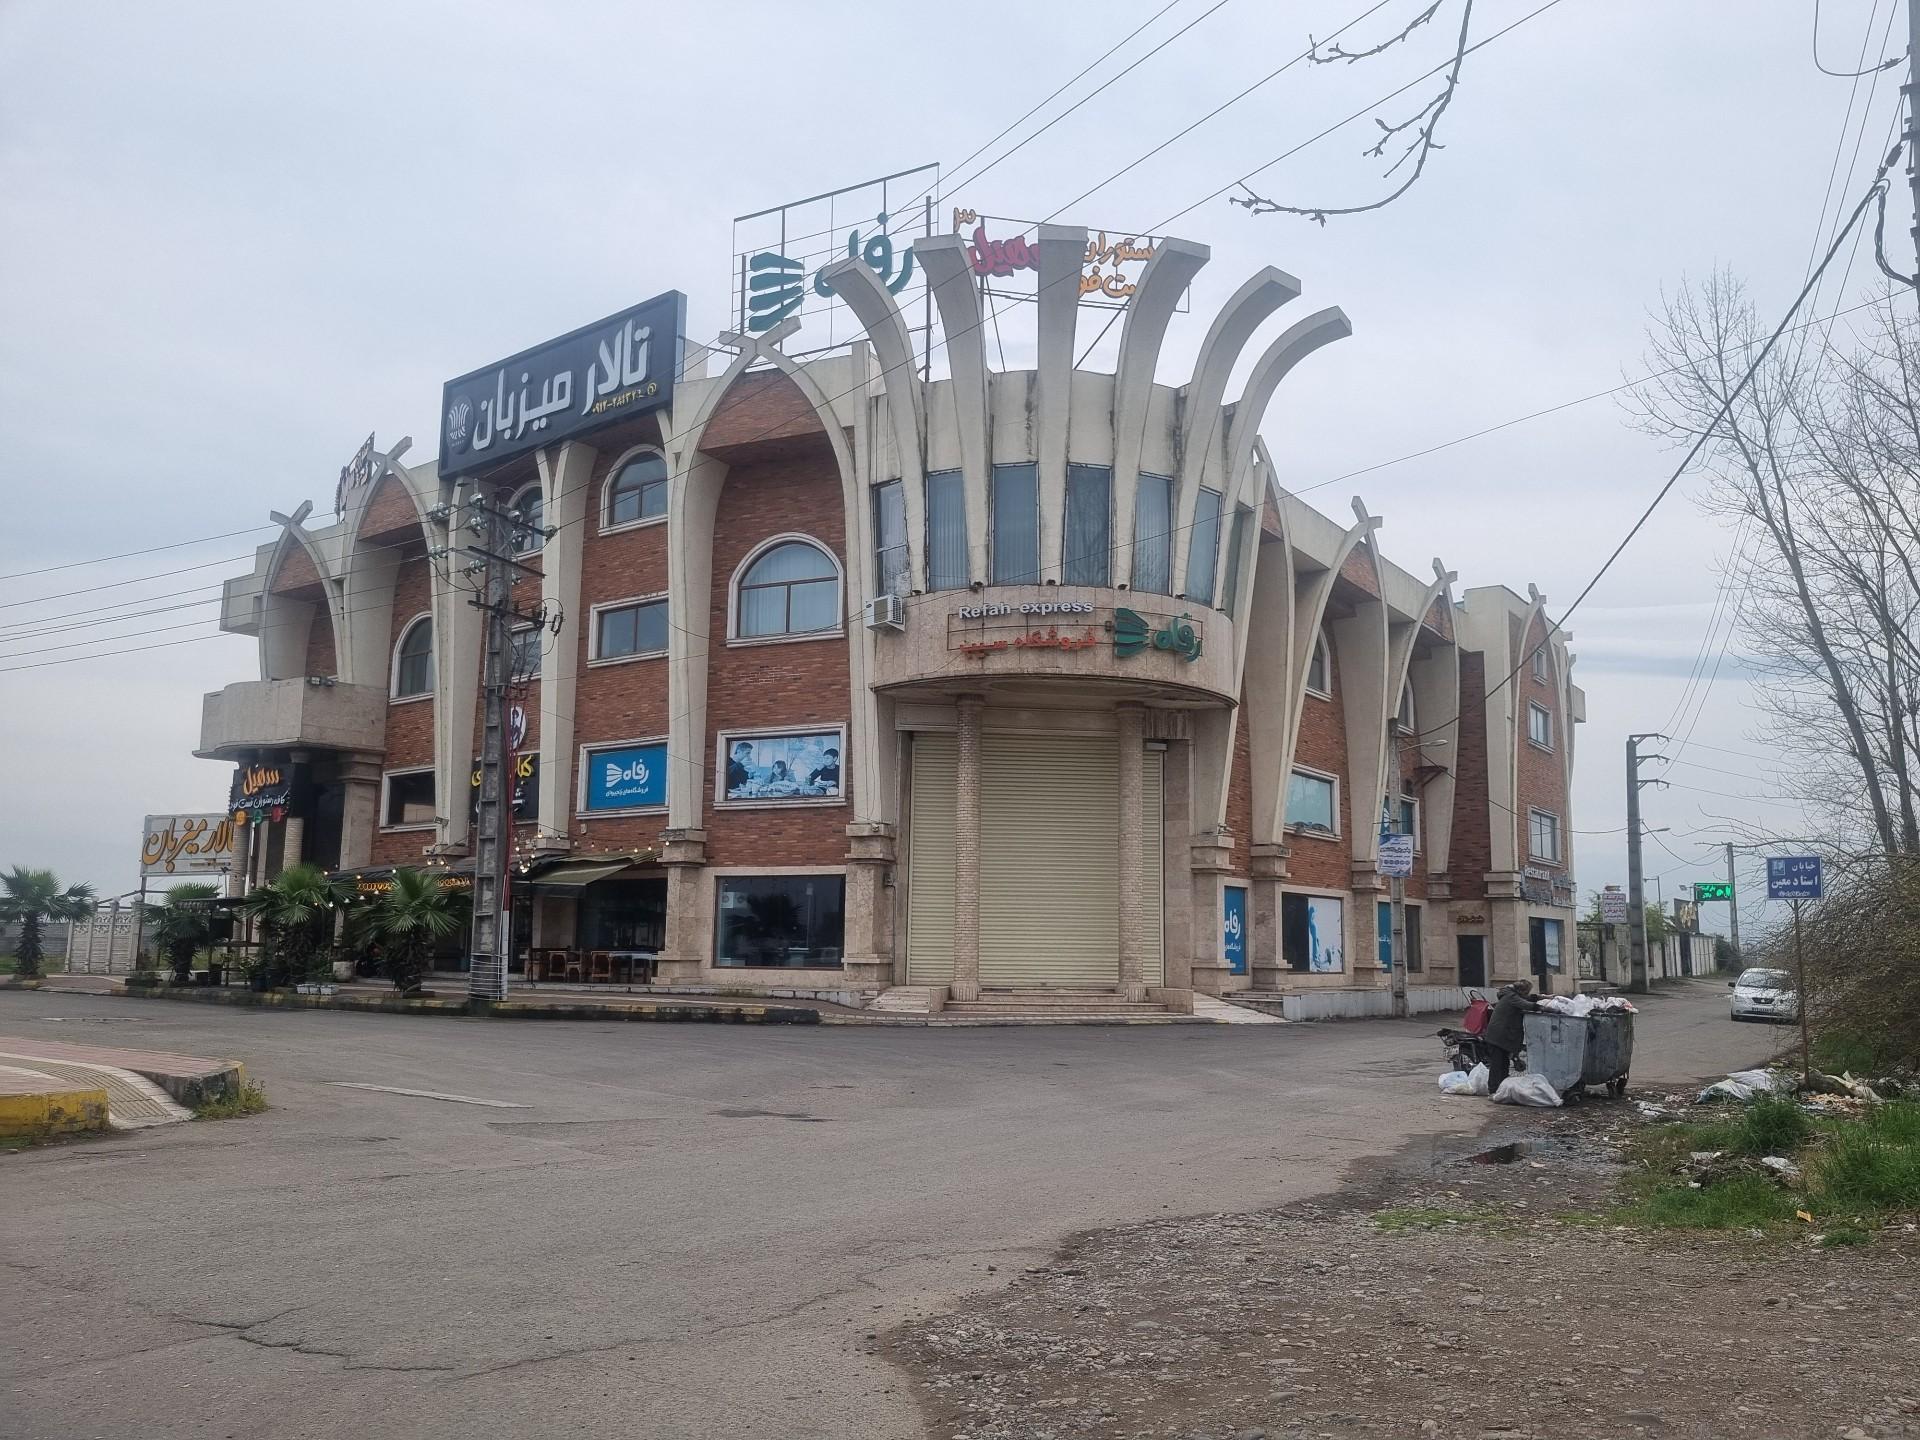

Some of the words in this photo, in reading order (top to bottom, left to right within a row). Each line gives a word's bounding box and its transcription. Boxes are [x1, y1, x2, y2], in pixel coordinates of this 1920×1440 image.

[581, 318, 650, 416] تالار
[472, 368, 573, 451] میزبان
[959, 605, 1012, 620] Refah
[1019, 600, 1095, 616] express
[1014, 626, 1096, 651] فروشگاه
[1152, 612, 1203, 663] رفاه
[243, 766, 280, 796] سهیل
[622, 758, 649, 785] رفاه
[1791, 861, 1817, 872] خیابان
[1771, 878, 1791, 889] معین
[1792, 875, 1818, 886] استاد
